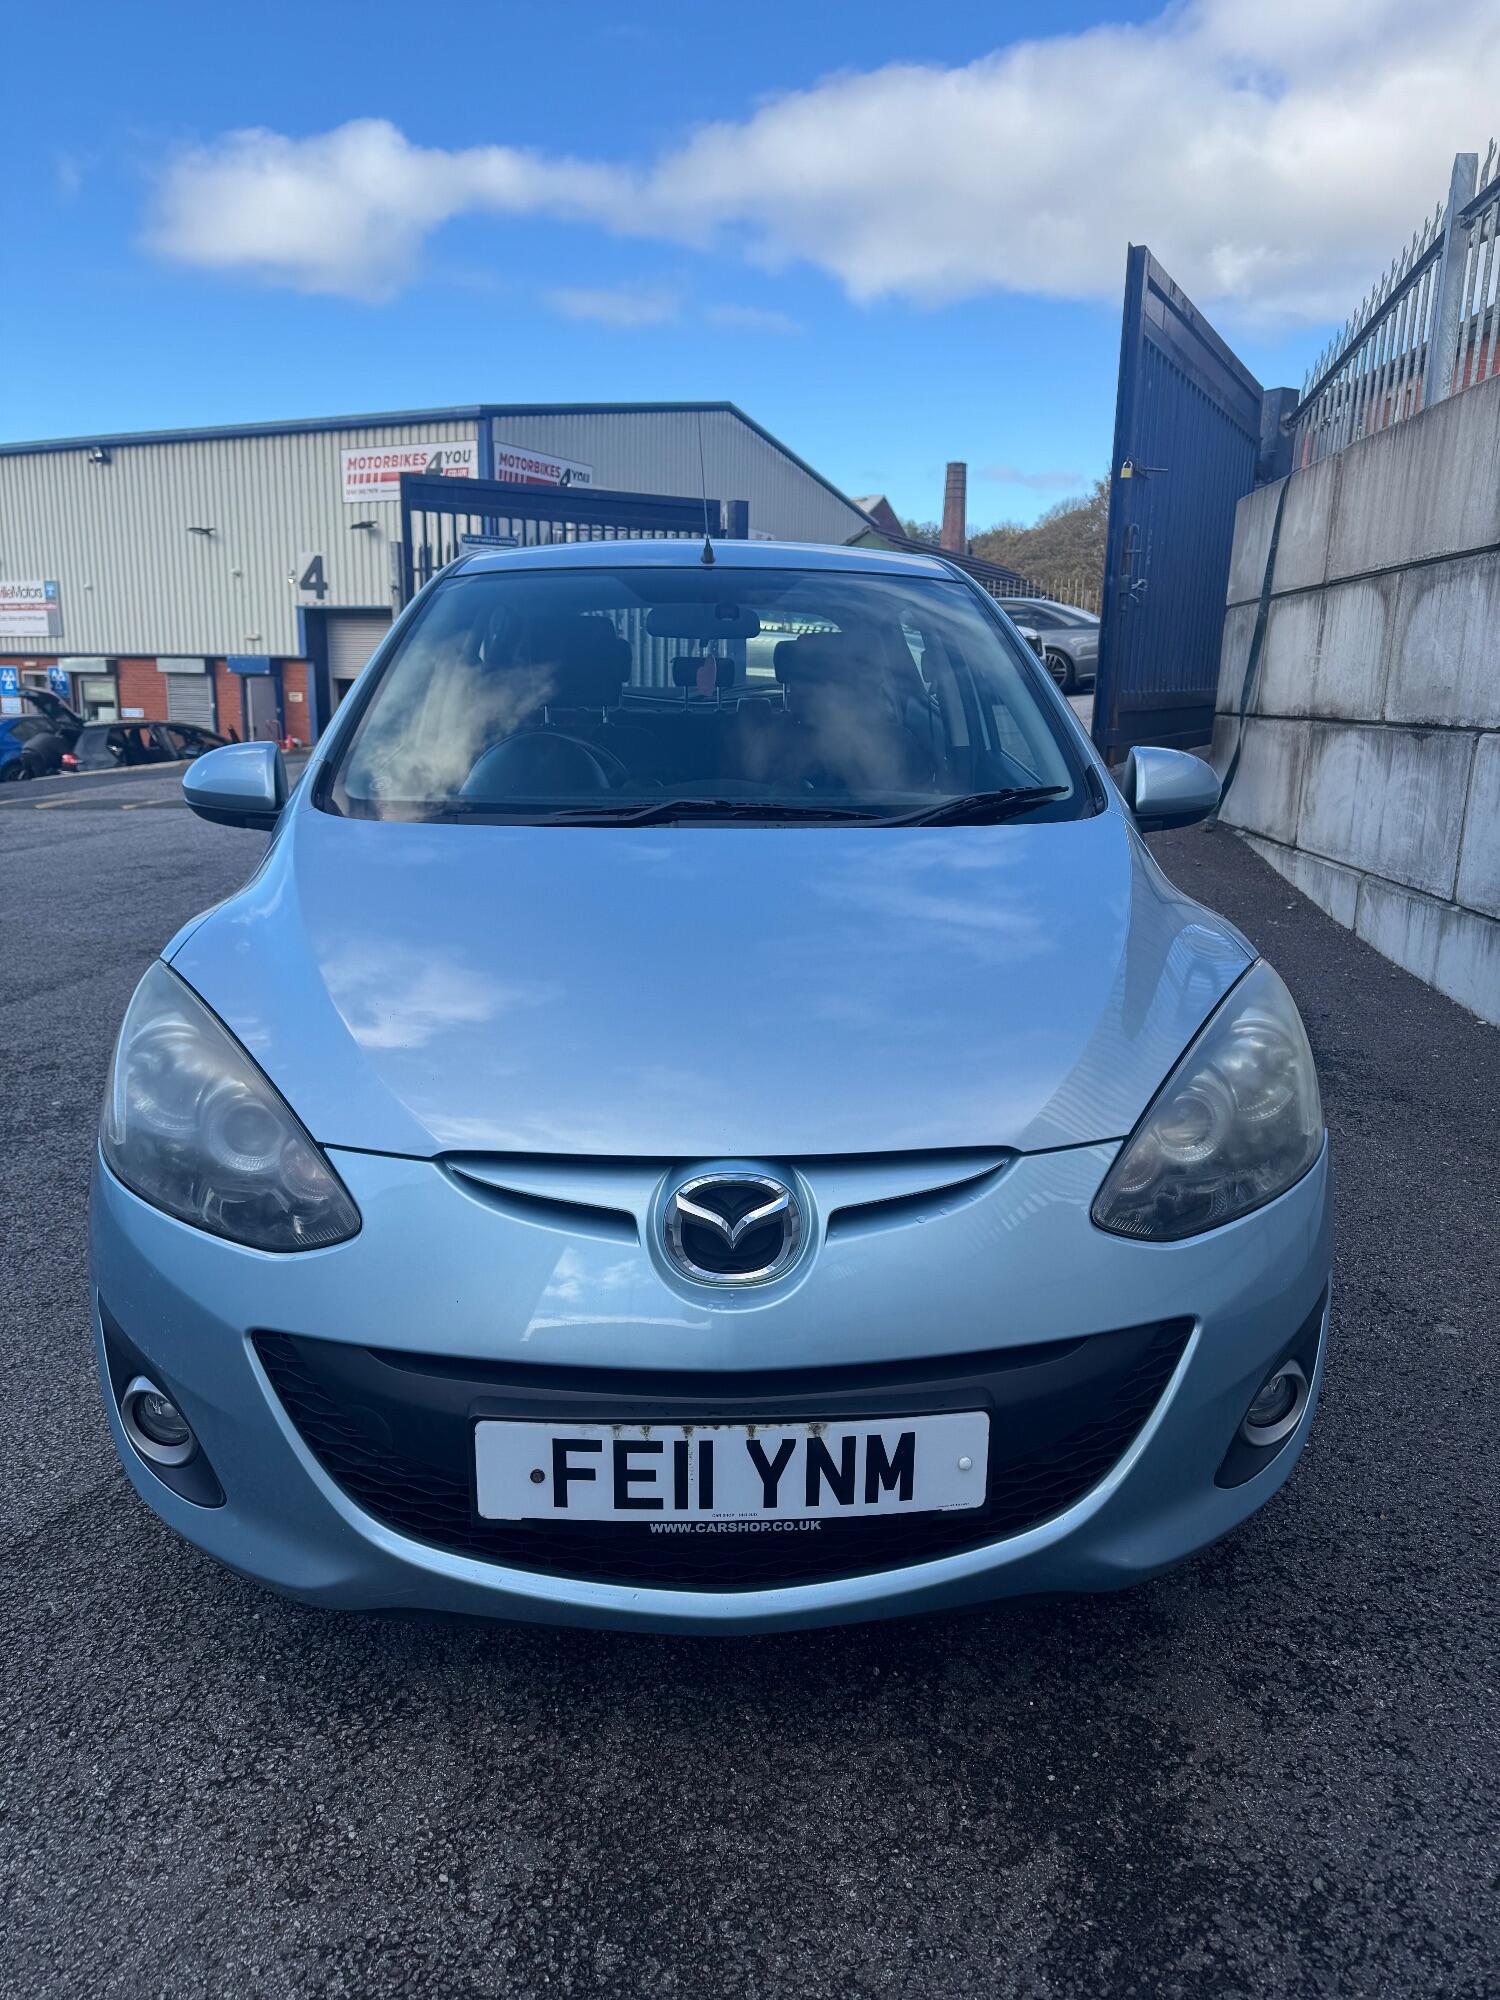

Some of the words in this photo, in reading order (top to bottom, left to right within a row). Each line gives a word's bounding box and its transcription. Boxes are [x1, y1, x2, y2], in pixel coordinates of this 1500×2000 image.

[347, 452, 428, 471] MOTORBIKES
[424, 451, 443, 475] 4
[444, 449, 471, 464] YOU
[499, 452, 561, 478] MOTORBIKES
[300, 555, 328, 600] 4
[552, 1438, 713, 1510] FE11
[746, 1432, 915, 1508] YNM
[650, 1521, 821, 1533] WWW.CARSHOP.CO.UK
